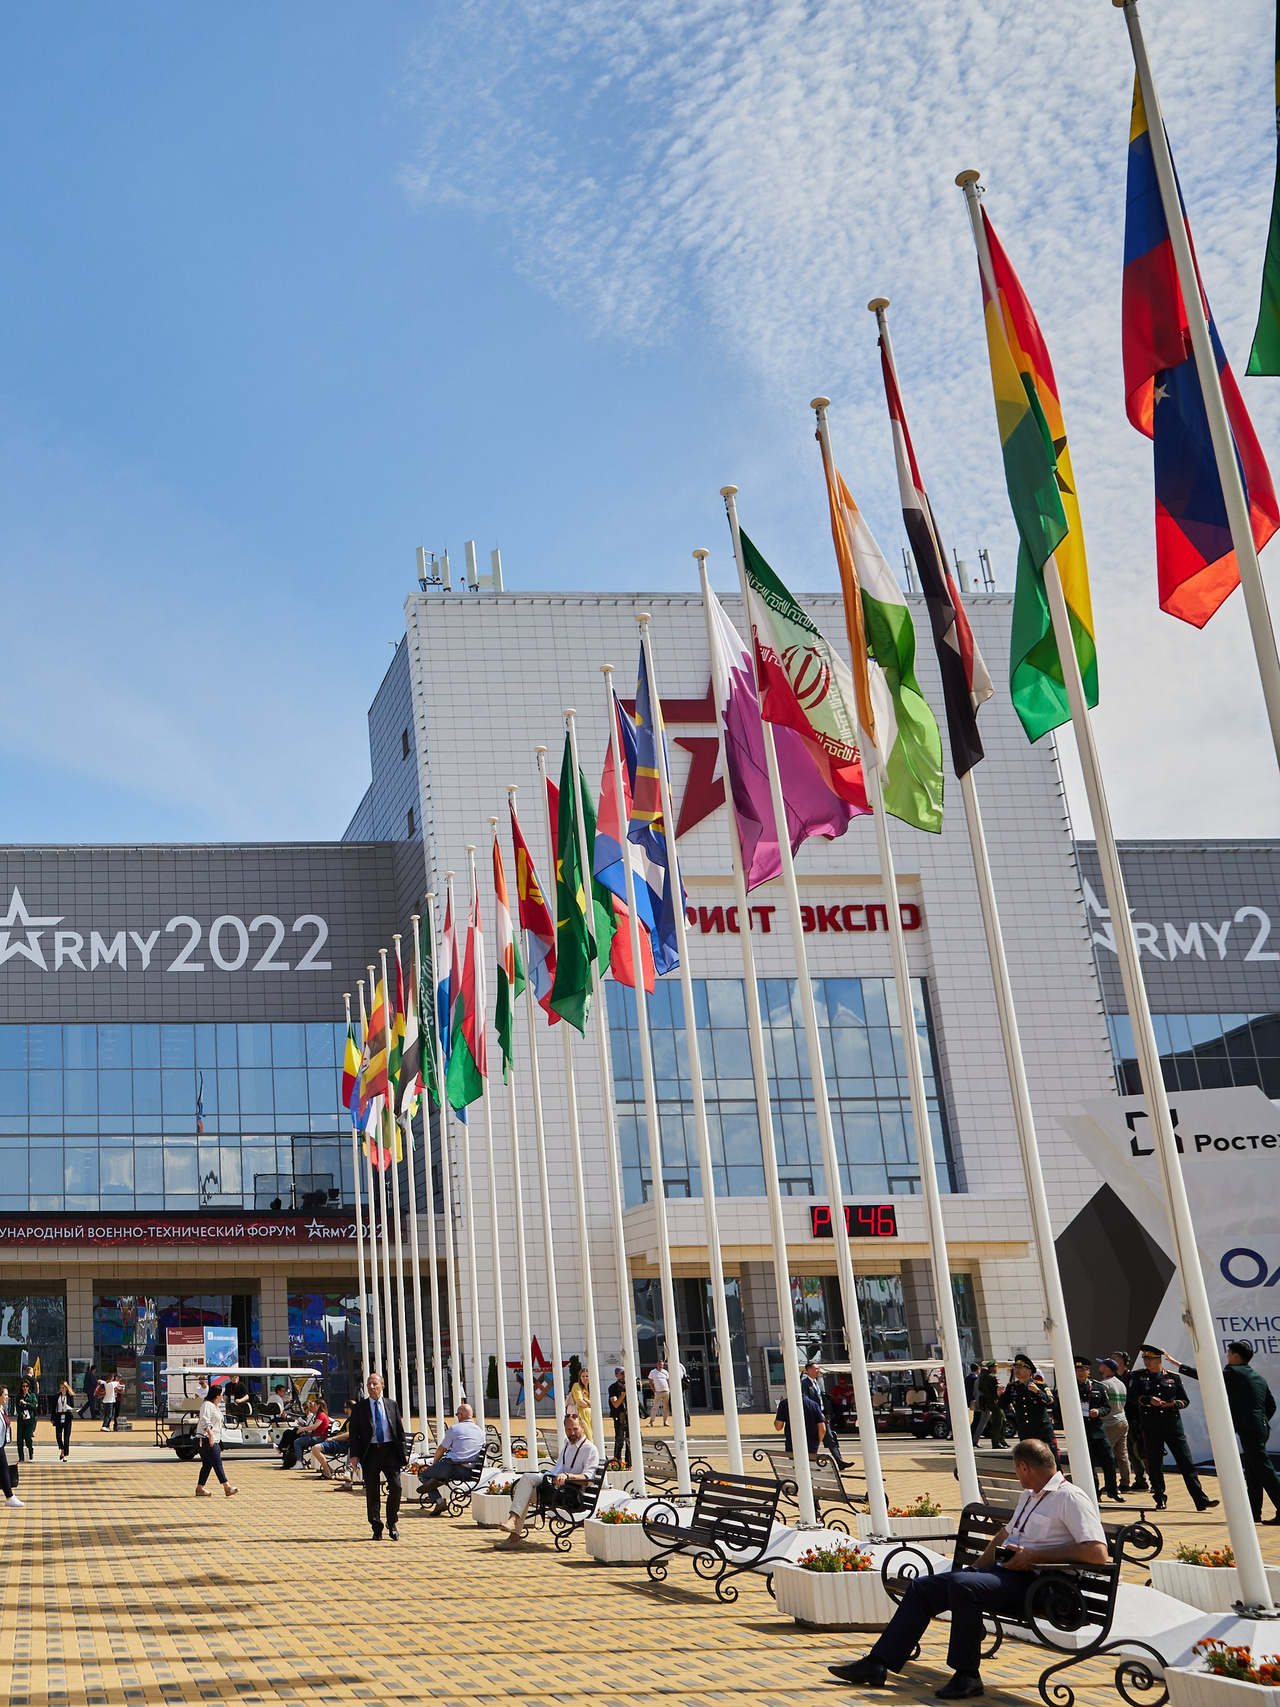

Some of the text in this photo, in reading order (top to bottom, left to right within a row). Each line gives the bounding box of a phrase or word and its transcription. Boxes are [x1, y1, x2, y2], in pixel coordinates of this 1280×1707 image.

[1194, 1133, 1280, 1153] Росте
[88, 1224, 245, 1239] ВОЕННО-ТЕХНИЧЕСКИЙ
[247, 1225, 296, 1238] ФОРУМ
